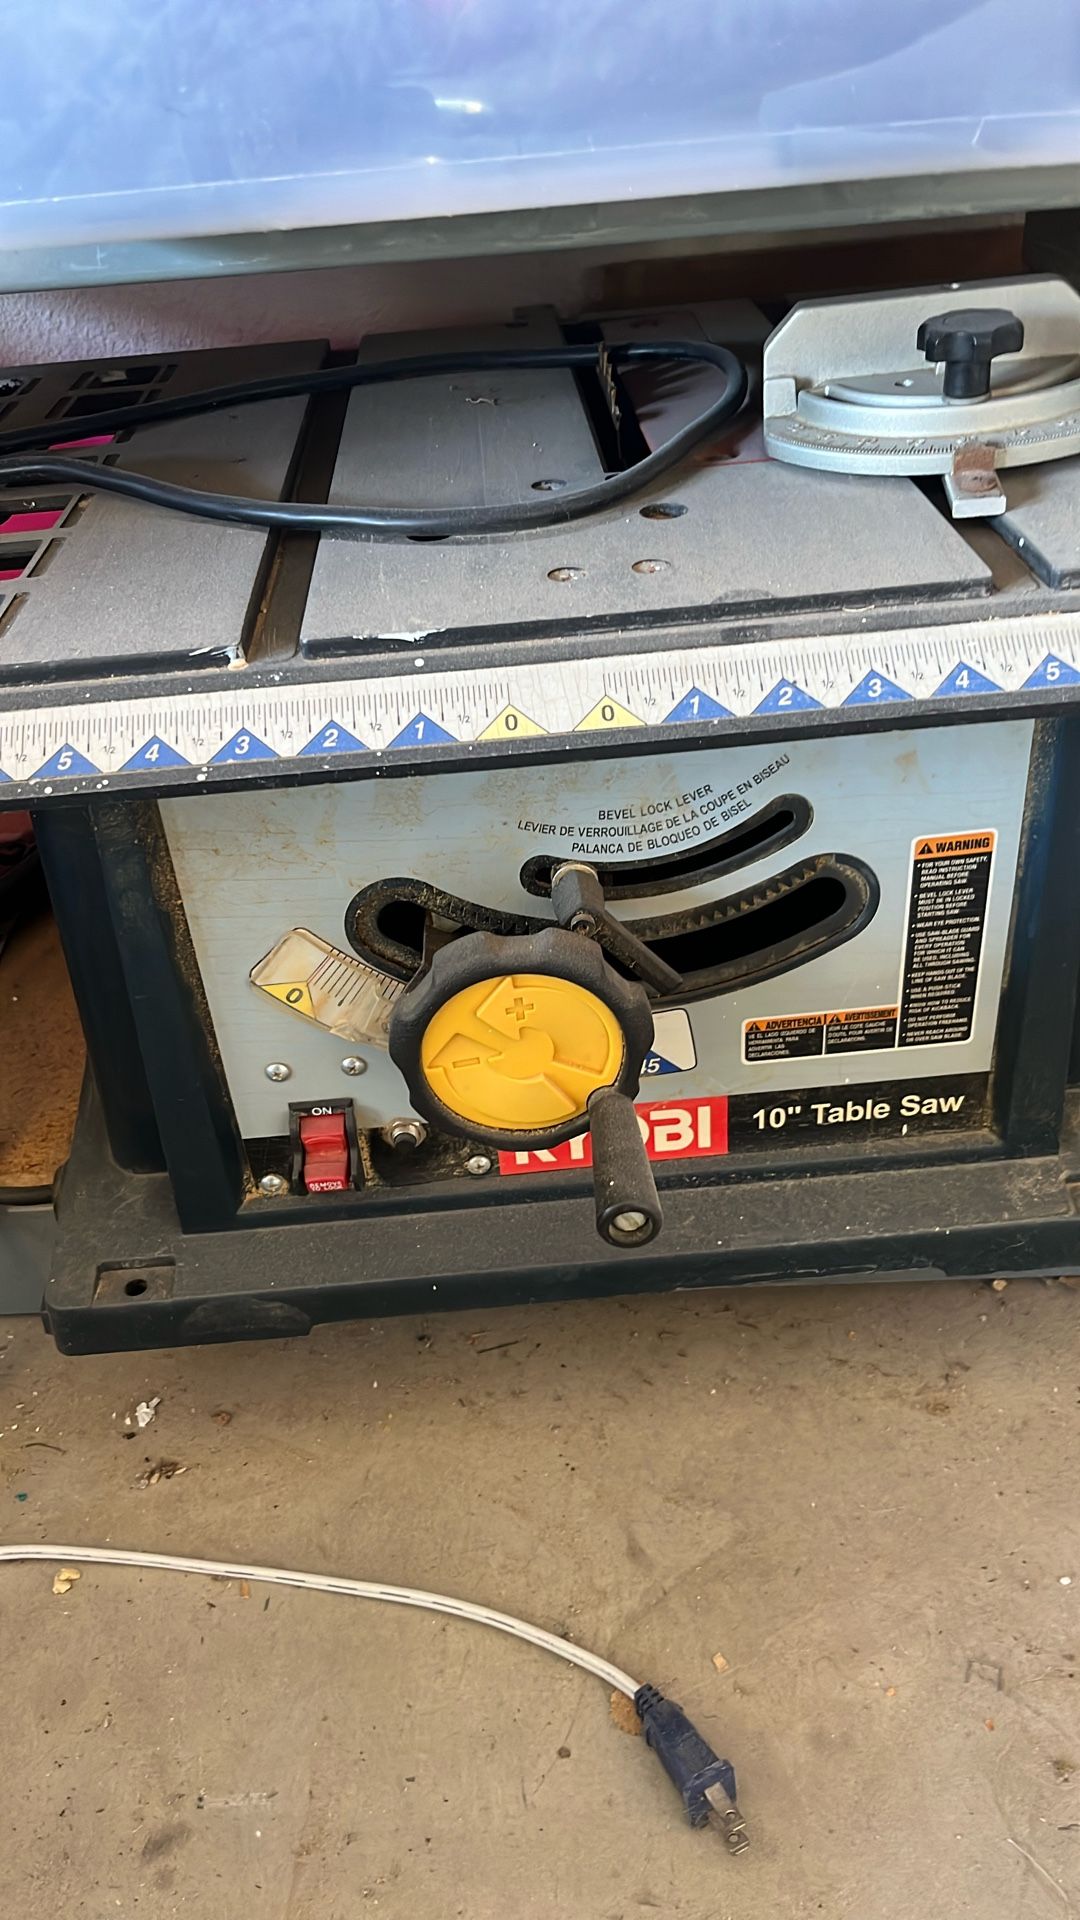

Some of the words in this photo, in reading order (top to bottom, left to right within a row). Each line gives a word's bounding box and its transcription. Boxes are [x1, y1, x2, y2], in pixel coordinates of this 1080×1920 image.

[57, 752, 73, 770] 5
[145, 743, 159, 761] 4
[235, 736, 250, 754] 3
[323, 729, 338, 747] 2
[415, 721, 425, 739] 1
[505, 714, 517, 730] 0
[602, 705, 614, 721] 0
[690, 695, 699, 714] 1
[778, 687, 792, 706] 2
[868, 679, 882, 697] 3
[956, 670, 969, 688] 4
[1046, 662, 1060, 680] 5
[518, 819, 556, 835] LEVIER
[560, 826, 574, 836] DE
[578, 821, 663, 837] VERROUILLAGE
[666, 816, 681, 829] DE
[682, 810, 699, 823] LA
[700, 790, 736, 815] COUPE
[736, 780, 753, 794] EN
[753, 754, 790, 784] BISEAU
[598, 808, 636, 820] BEVEL
[641, 800, 672, 817] LOCK
[675, 784, 713, 808] LEVER
[572, 842, 624, 854] PALANCA
[628, 841, 643, 853] DE
[647, 825, 701, 849] BLOQUEO
[703, 816, 720, 831] DE
[720, 799, 752, 822] BISEL
[936, 838, 990, 852] WARNING
[286, 987, 303, 1004] 0
[765, 1016, 822, 1029] ADVERTENCIA
[312, 1106, 332, 1116] ON
[752, 1106, 802, 1130] 10"
[811, 1099, 891, 1125] Table
[900, 1095, 965, 1116] Saw
